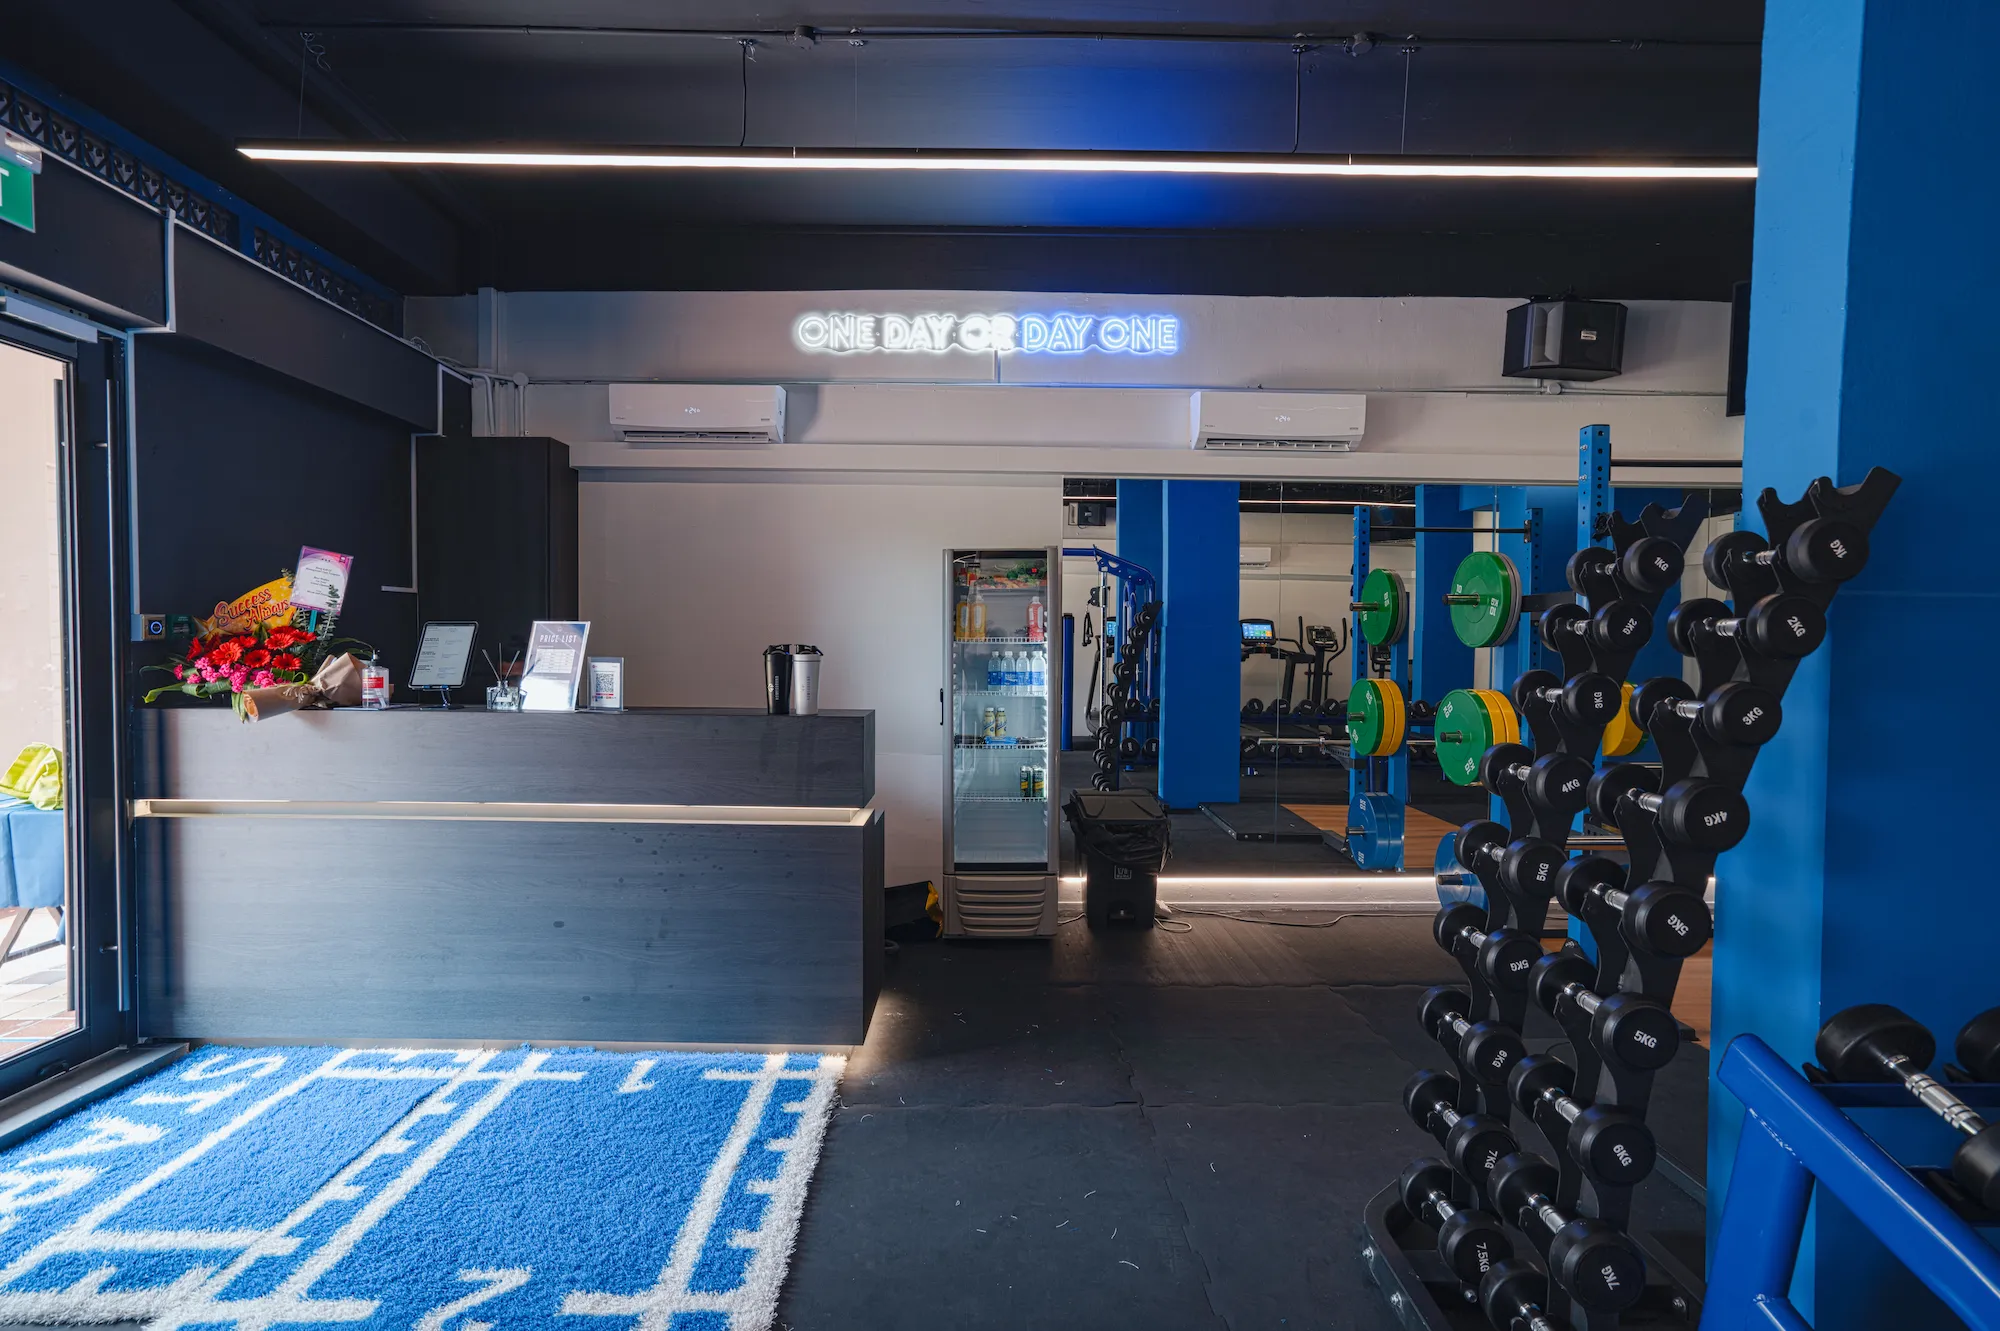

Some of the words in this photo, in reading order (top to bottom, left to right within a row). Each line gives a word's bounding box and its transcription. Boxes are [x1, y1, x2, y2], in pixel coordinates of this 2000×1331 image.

[798, 316, 876, 349] ONE
[883, 316, 954, 350] DAY
[959, 316, 1015, 351] OR
[1024, 317, 1092, 349] DAY
[1101, 318, 1177, 350] ONE
[1830, 540, 1847, 558] 1KG
[1655, 557, 1668, 571] 1KG
[214, 588, 272, 626] Success
[244, 599, 290, 630] Always
[1623, 618, 1637, 634] 2KG
[1787, 616, 1805, 637] 2KG
[540, 634, 559, 643] PRICE
[561, 634, 577, 643] LIST
[1594, 692, 1603, 708] 3KG
[1742, 707, 1763, 725] 3KG
[1562, 779, 1580, 792] 4KG
[1704, 811, 1727, 826] 4KG
[1536, 863, 1549, 881] 5KG
[1668, 915, 1688, 936] 5KG
[1510, 960, 1529, 971] 5KG
[1634, 1030, 1657, 1048] 5KG
[1492, 1050, 1507, 1067] 6KG
[0, 1053, 287, 1234] STAR
[1485, 1150, 1498, 1169] 7KG
[1613, 1145, 1632, 1166] 6KG
[1477, 1243, 1490, 1272] 7.5KG
[1601, 1265, 1620, 1290] 7KG
